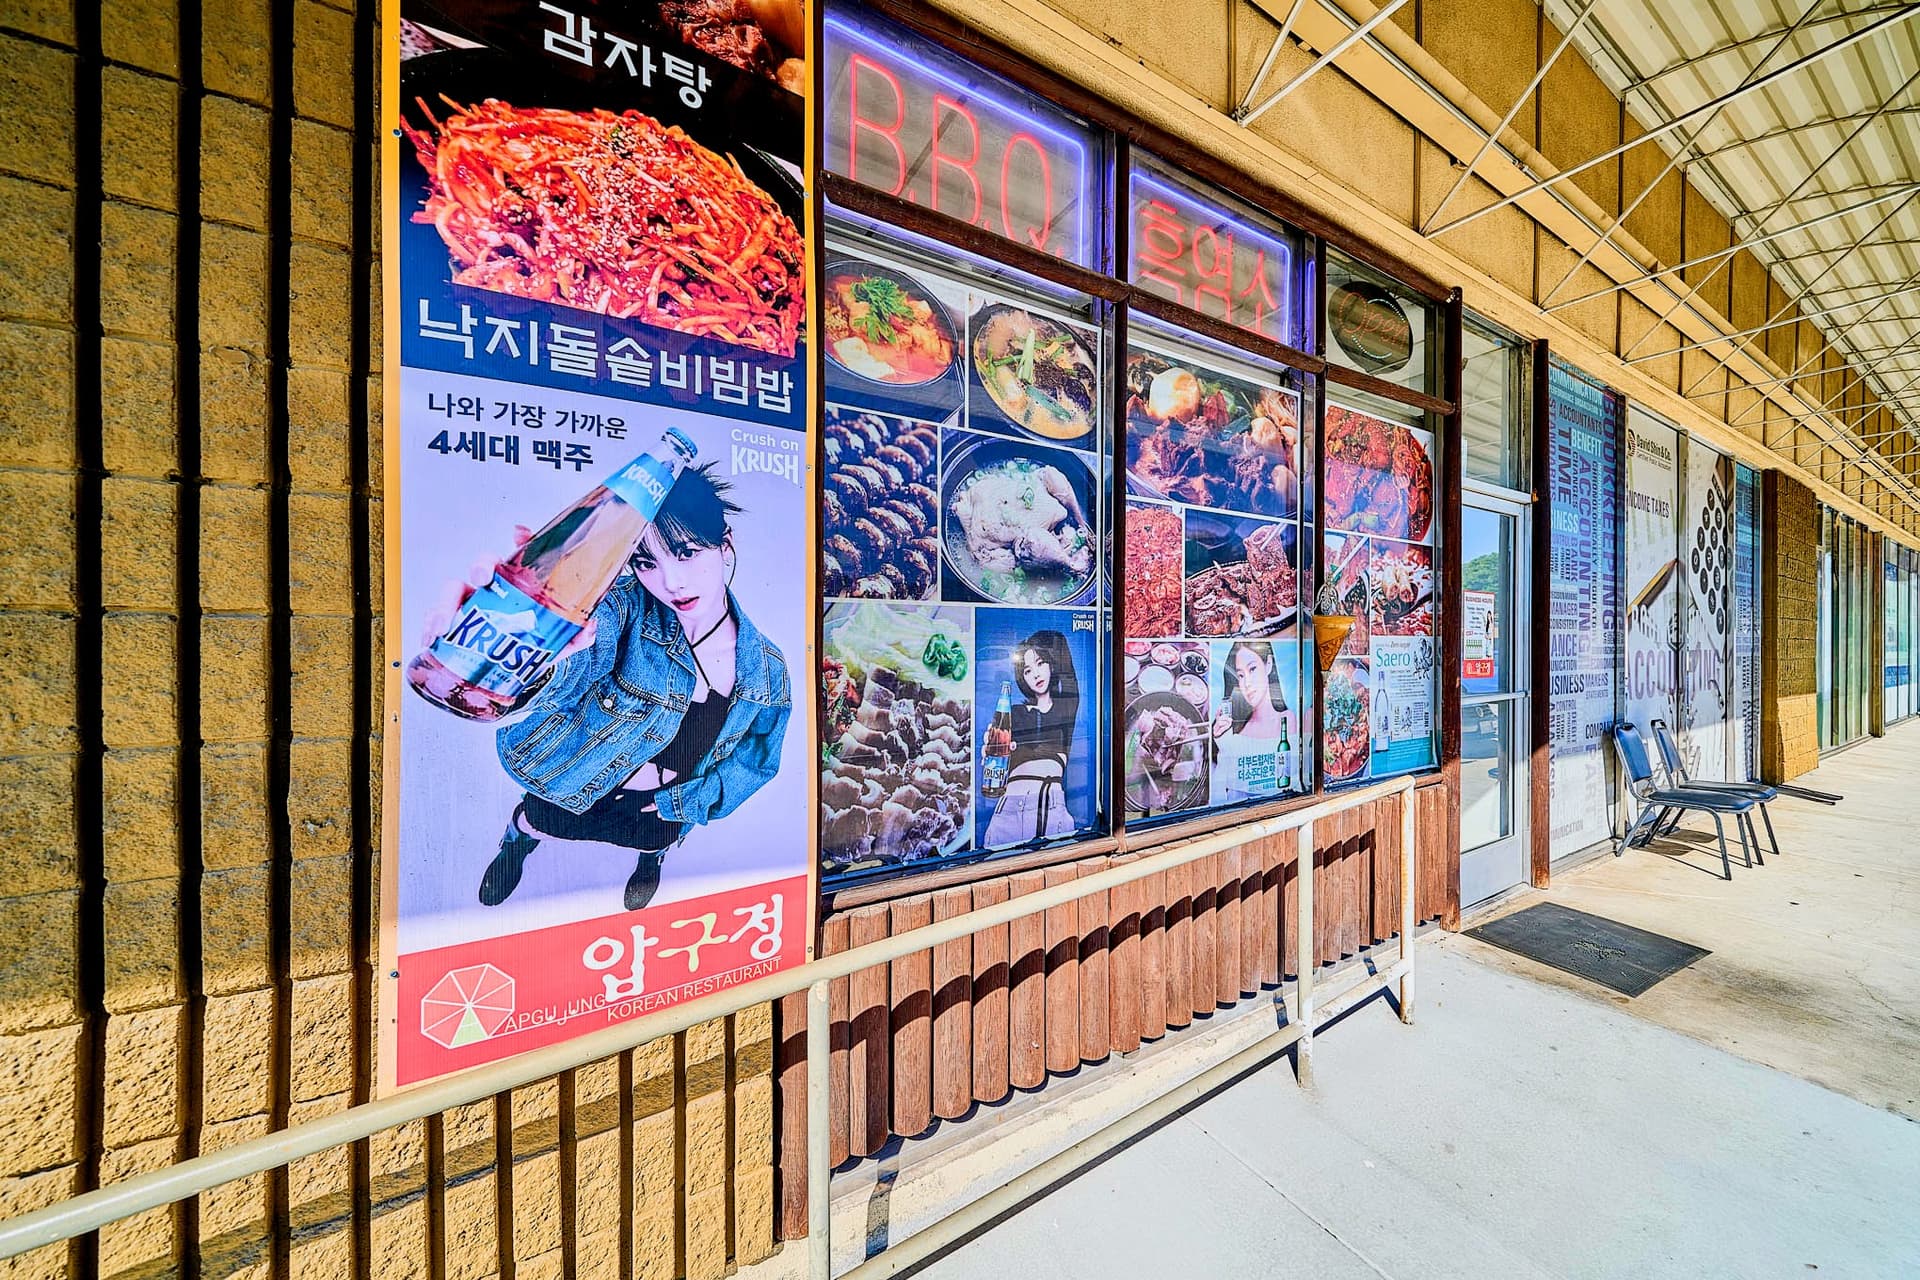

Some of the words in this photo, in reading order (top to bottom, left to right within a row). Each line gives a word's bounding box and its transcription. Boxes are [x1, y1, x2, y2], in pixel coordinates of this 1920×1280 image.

[539, 1, 712, 108] 감자탕
[1337, 292, 1410, 350] Open
[417, 298, 795, 415] 낙지돌솥비빔밥
[427, 393, 484, 422] 나와
[493, 399, 547, 429] 가장
[554, 407, 629, 440] 가까운
[1559, 403, 1602, 435] ACCOUNTANTS
[427, 429, 520, 466] 4세대
[531, 438, 595, 472] 맥주
[730, 428, 776, 448] Crush
[780, 439, 800, 451] on
[1571, 428, 1602, 458] BENEFIT
[1637, 434, 1651, 452] David
[1651, 440, 1661, 456] Shin
[620, 463, 668, 507] KRUSH
[730, 444, 800, 486] KRUSH
[1558, 428, 1572, 505] TIME
[1602, 395, 1615, 629] BOOKKEEPING
[1628, 490, 1651, 512] NCOME
[1652, 498, 1670, 518] TAXES
[1579, 455, 1591, 653] ACCOUNTING
[444, 606, 553, 684] KRUSH
[1073, 619, 1094, 633] KRUSH
[1550, 633, 1577, 657] ANCE
[1376, 648, 1411, 668] Saero
[1550, 659, 1577, 672] UNICATION
[1550, 674, 1585, 696] USINESS
[582, 894, 784, 1002] 압구정
[606, 990, 680, 1021] KOREAN
[683, 957, 782, 999] RESTAURANT
